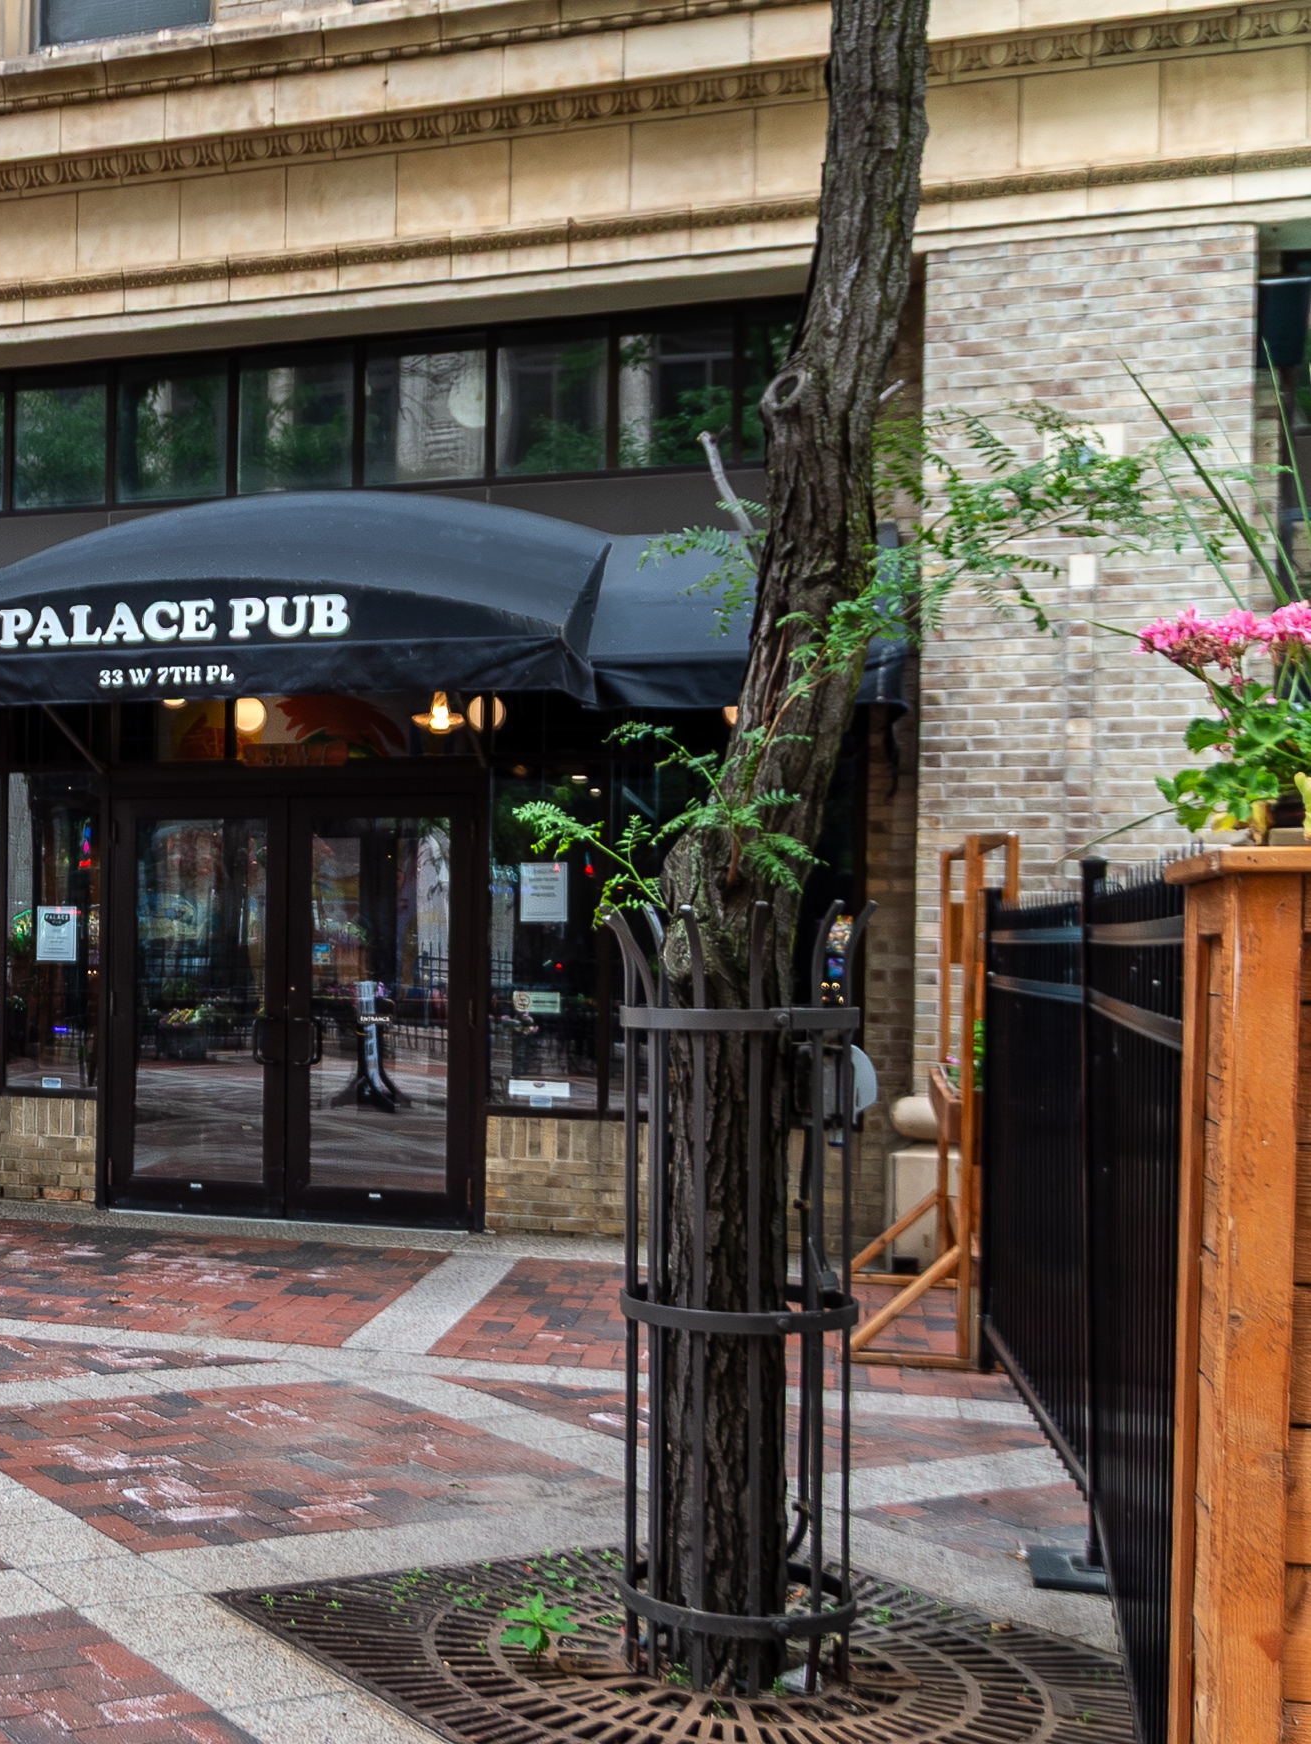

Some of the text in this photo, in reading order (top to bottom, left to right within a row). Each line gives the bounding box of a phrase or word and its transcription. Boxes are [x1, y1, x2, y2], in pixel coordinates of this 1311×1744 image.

[228, 594, 351, 639] PUB
[99, 665, 236, 688] 33 W 7TH PL
